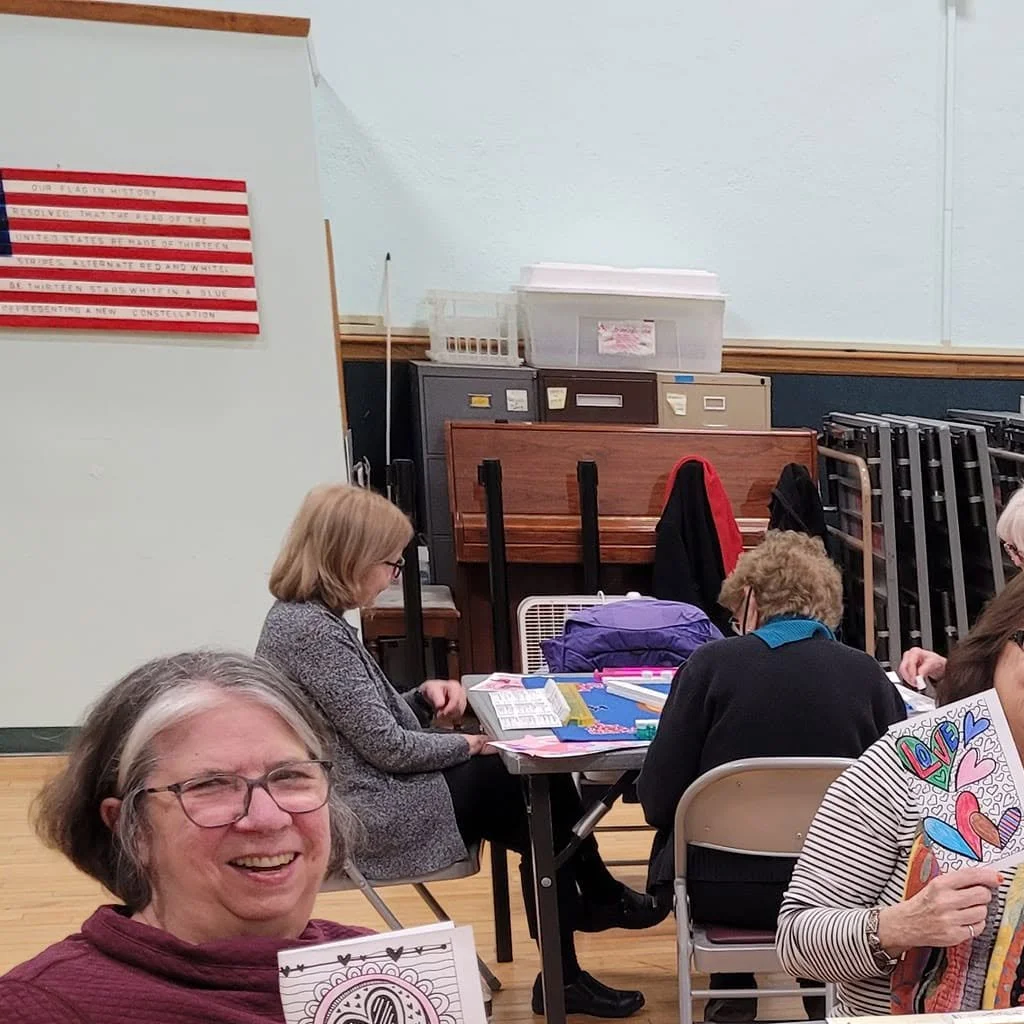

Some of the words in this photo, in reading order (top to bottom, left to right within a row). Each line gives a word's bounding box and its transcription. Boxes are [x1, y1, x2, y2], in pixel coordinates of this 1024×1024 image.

[31, 184, 52, 192] OUR
[60, 185, 89, 194] FLAG
[93, 187, 105, 195] IN
[110, 187, 157, 198] HISTORY
[80, 210, 106, 219] THAT
[110, 212, 129, 220] THE
[135, 213, 164, 222] FLAG
[169, 215, 182, 223] OF
[187, 215, 208, 225] THE
[15, 233, 59, 243] UNITED
[64, 235, 105, 245] STATES
[111, 237, 122, 246] BE
[127, 238, 157, 248] MADE
[161, 240, 174, 248] OF
[178, 240, 229, 250] THIRTEEN
[72, 259, 134, 270] ALTERNATE
[139, 262, 161, 271] RED
[165, 263, 187, 272] AND
[9, 280, 22, 290] BE
[28, 282, 83, 293] THIRTEEN
[89, 285, 126, 294] STARS
[129, 287, 163, 296] WHITE
[167, 287, 179, 297] IN
[199, 289, 229, 298] BLUE
[95, 307, 117, 316] NEW
[132, 309, 217, 320] CONSTELLATION
[901, 722, 958, 780] LOVE
